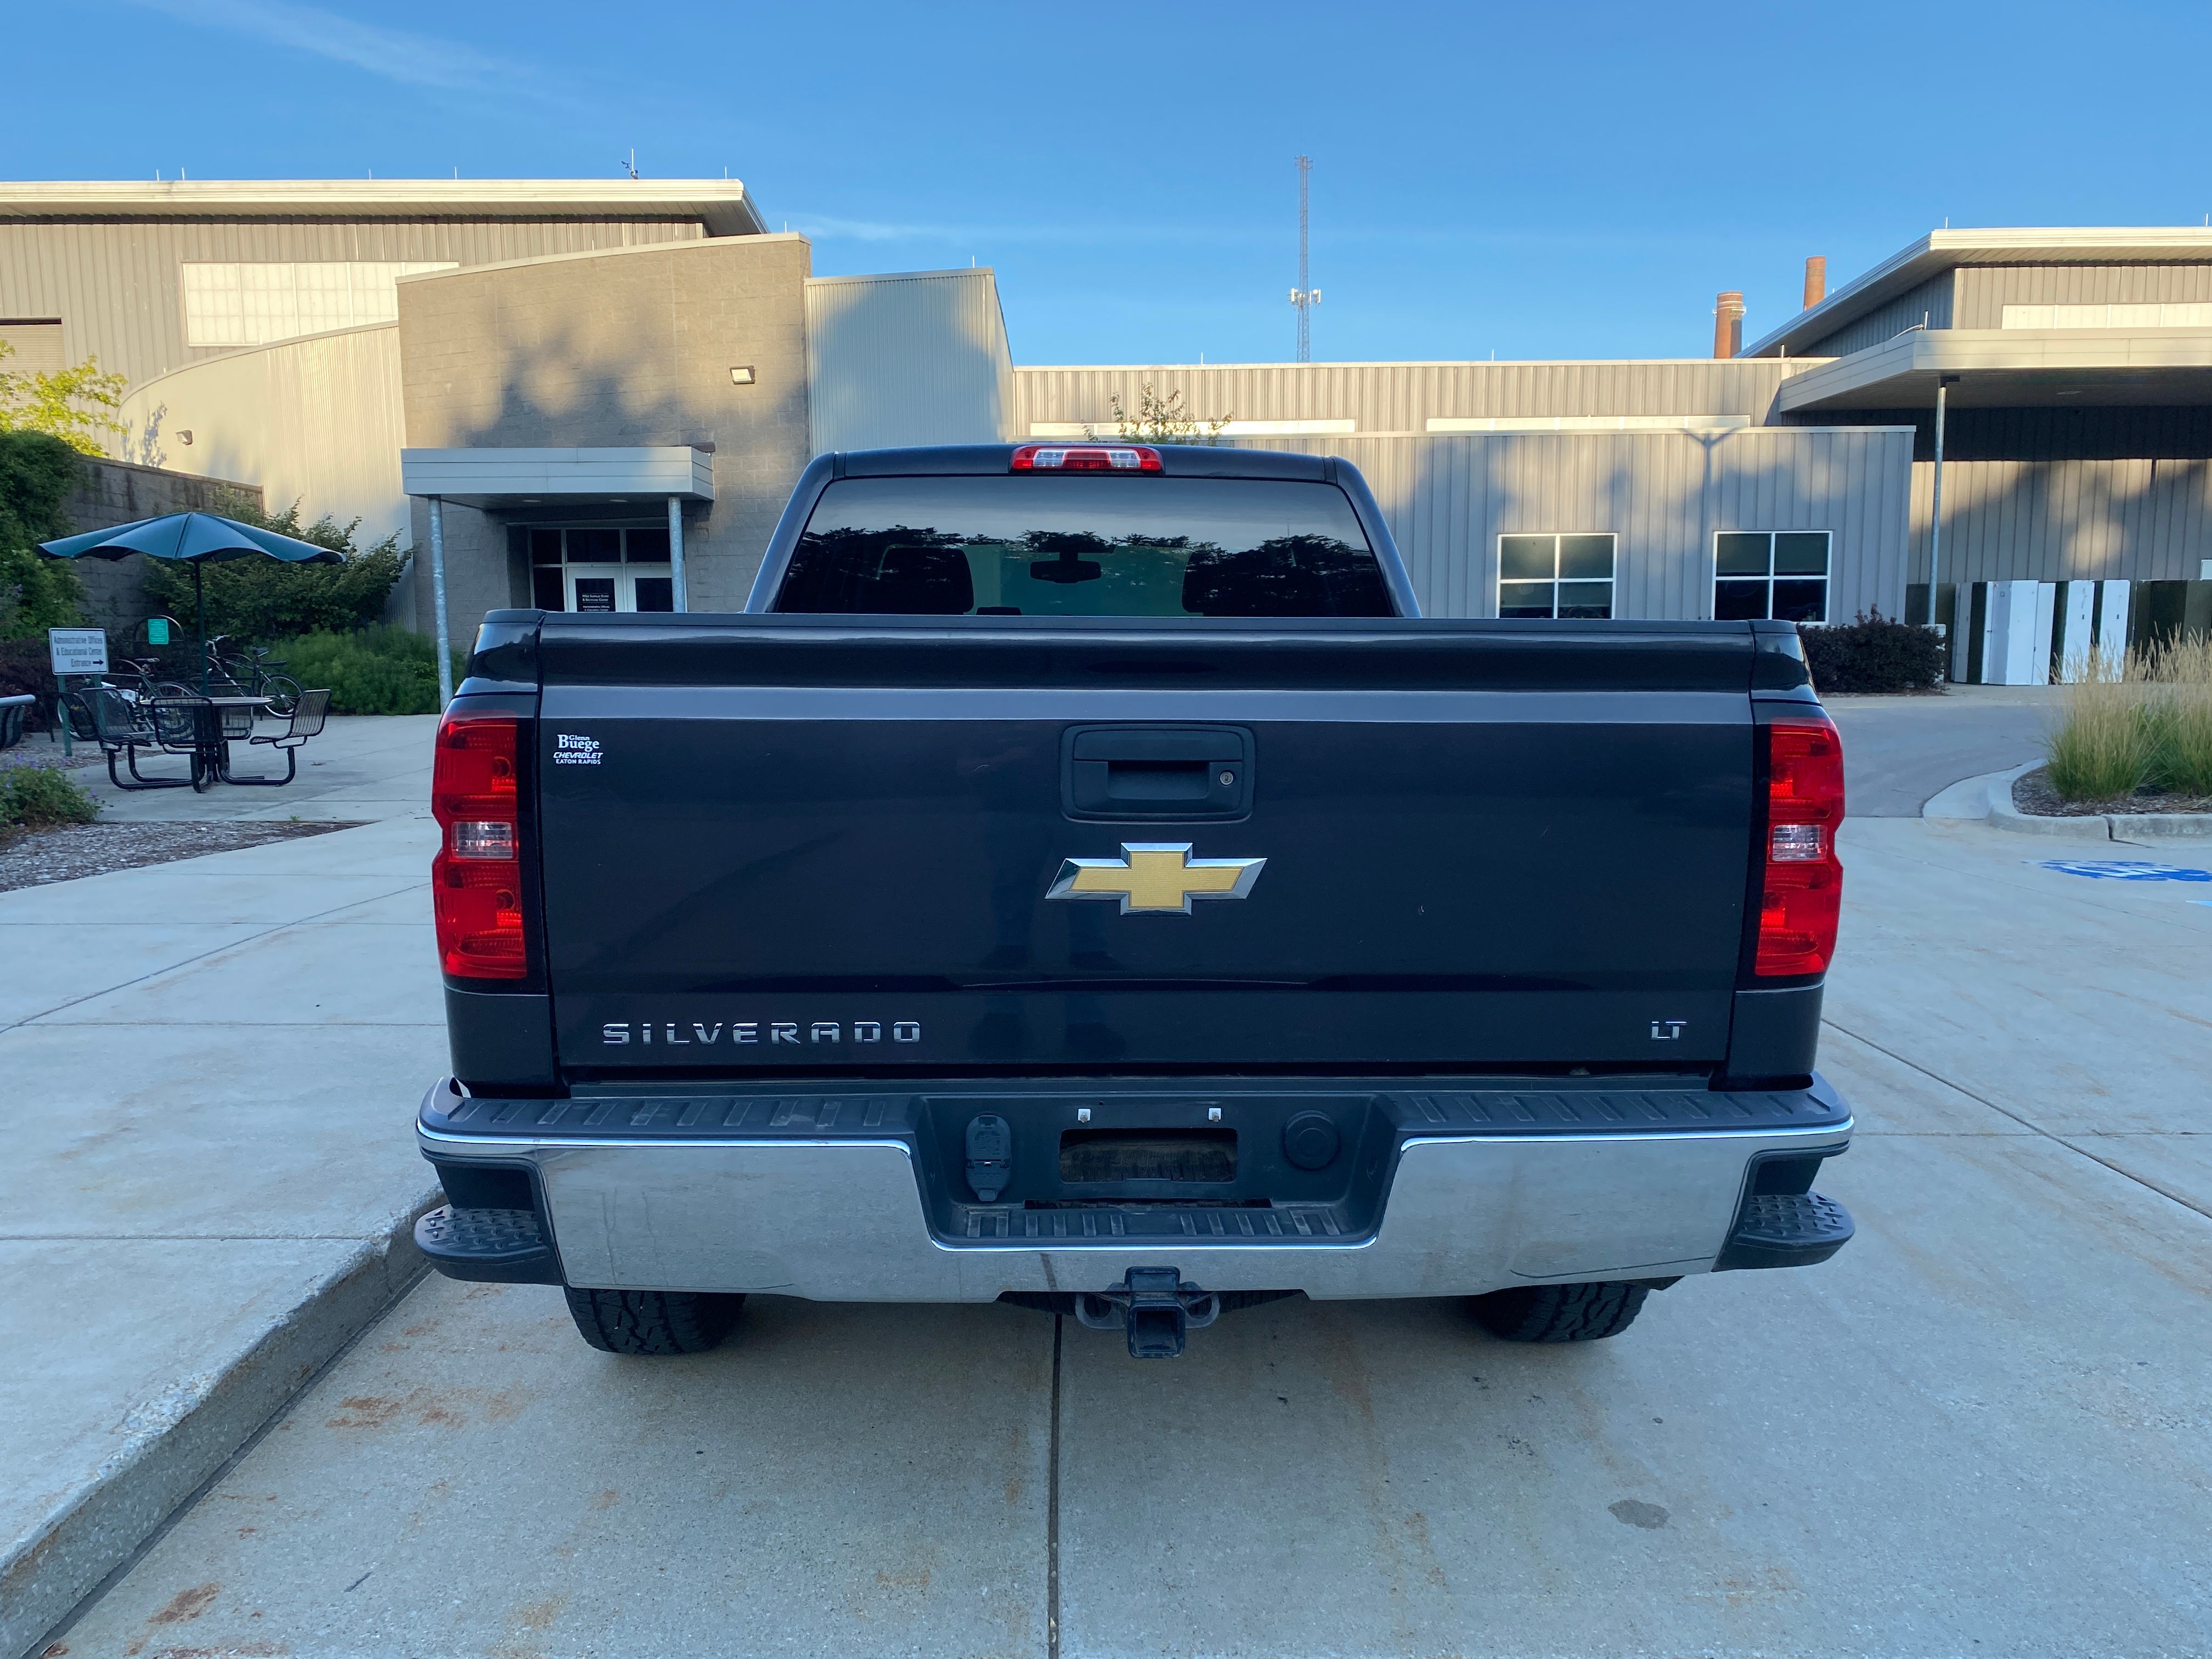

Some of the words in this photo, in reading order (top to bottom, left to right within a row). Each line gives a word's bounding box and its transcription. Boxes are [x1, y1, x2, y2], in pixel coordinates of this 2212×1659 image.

[71, 659, 92, 667] Entrance
[557, 734, 600, 753] Buege
[602, 1020, 921, 1045] SILVERADO
[1650, 1021, 1688, 1040] LT
